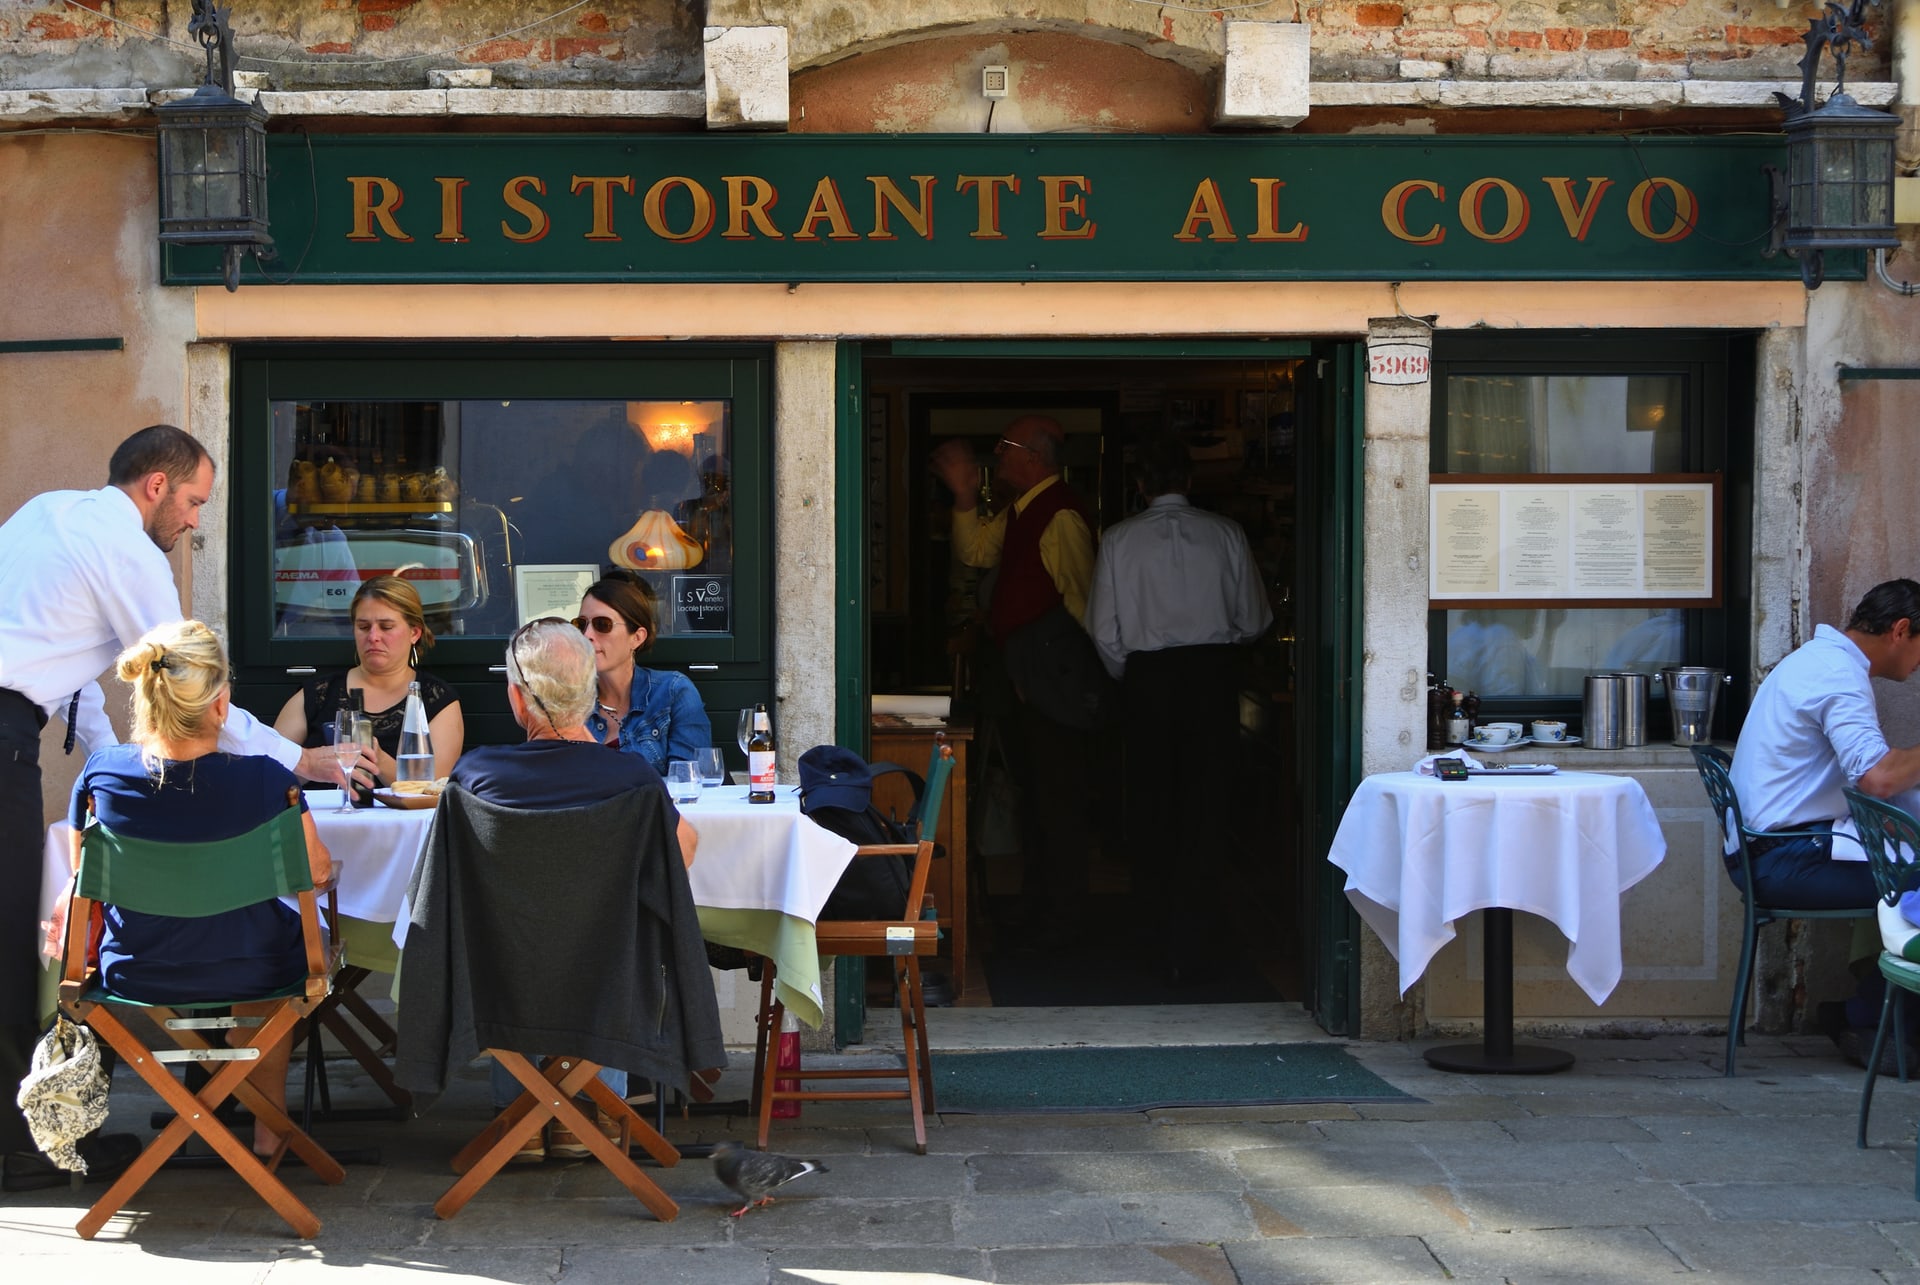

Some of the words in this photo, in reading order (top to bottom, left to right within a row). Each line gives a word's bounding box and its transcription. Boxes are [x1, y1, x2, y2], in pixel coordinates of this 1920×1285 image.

[347, 175, 1097, 243] RISTORANTE
[1175, 177, 1310, 244] AL
[1380, 177, 1698, 247] COVO
[275, 572, 320, 580] FAEMA
[677, 605, 700, 613] Locale
